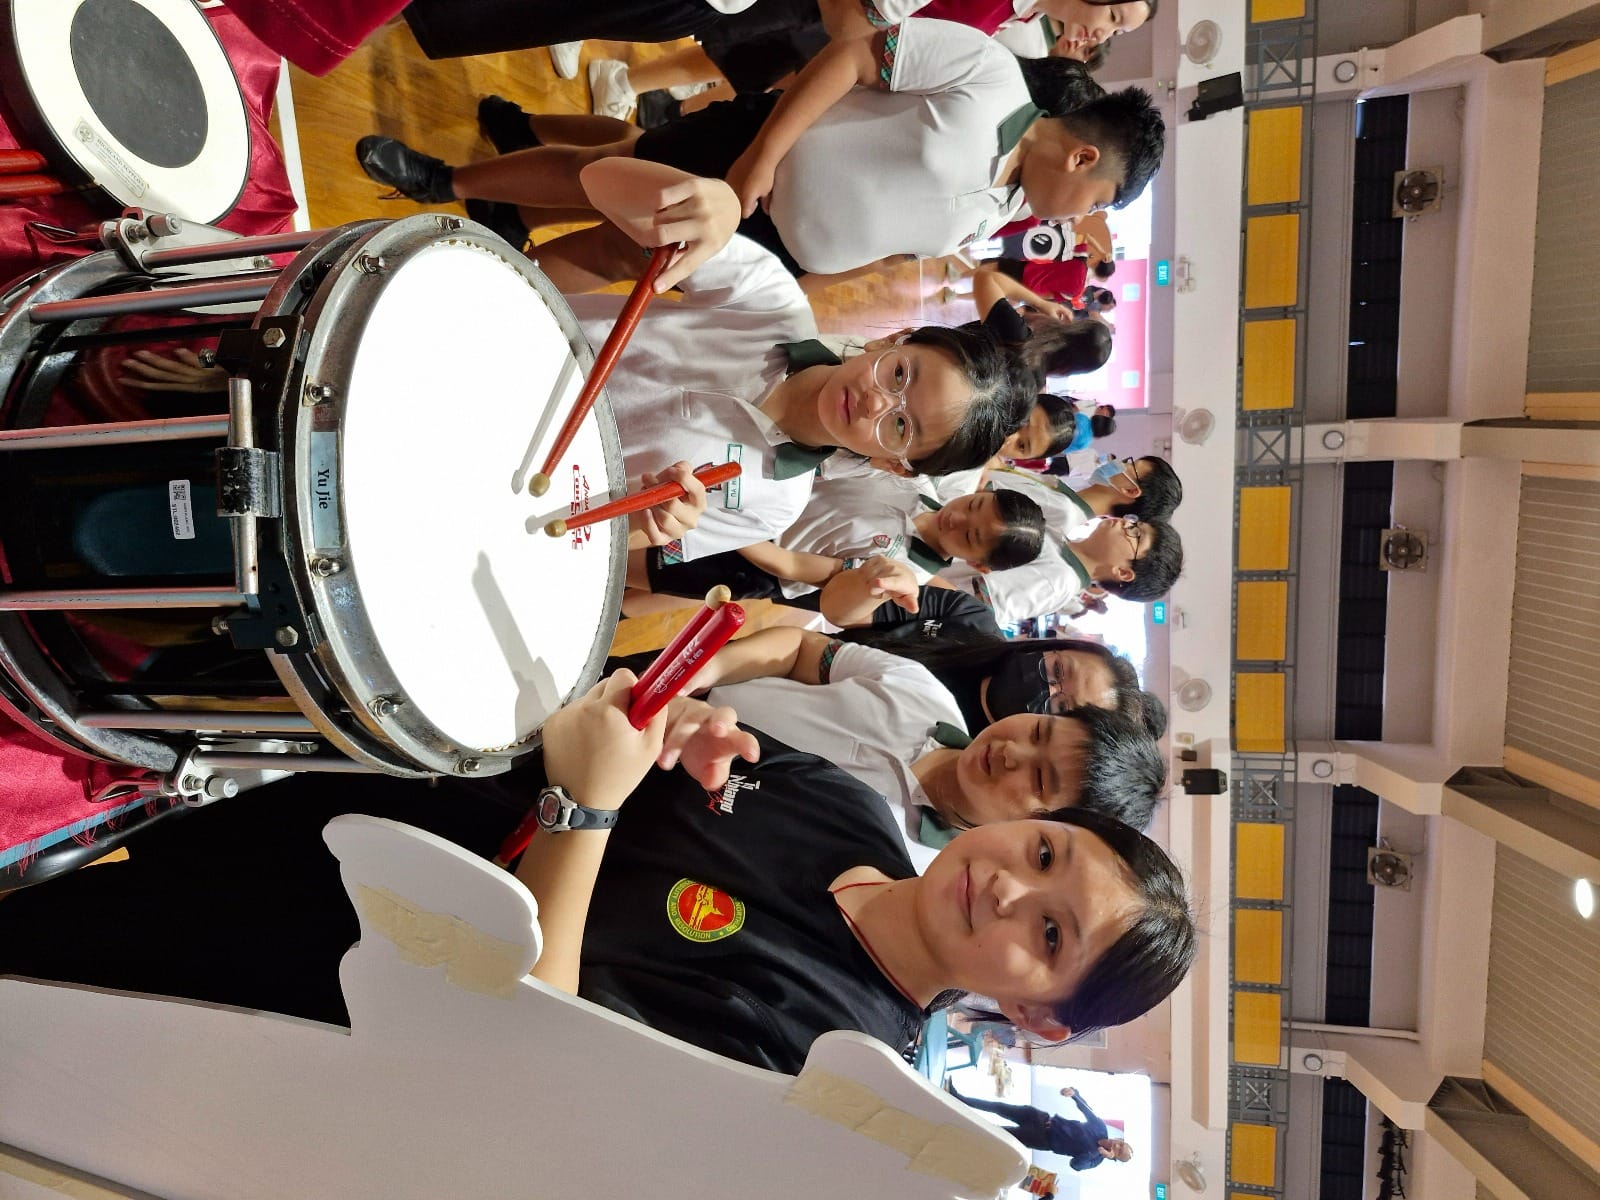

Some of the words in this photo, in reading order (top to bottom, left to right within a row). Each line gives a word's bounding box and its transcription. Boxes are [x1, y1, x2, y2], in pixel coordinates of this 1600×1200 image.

[1158, 265, 1168, 281] EXIT
[317, 468, 330, 487] Yu
[315, 490, 332, 510] Jie
